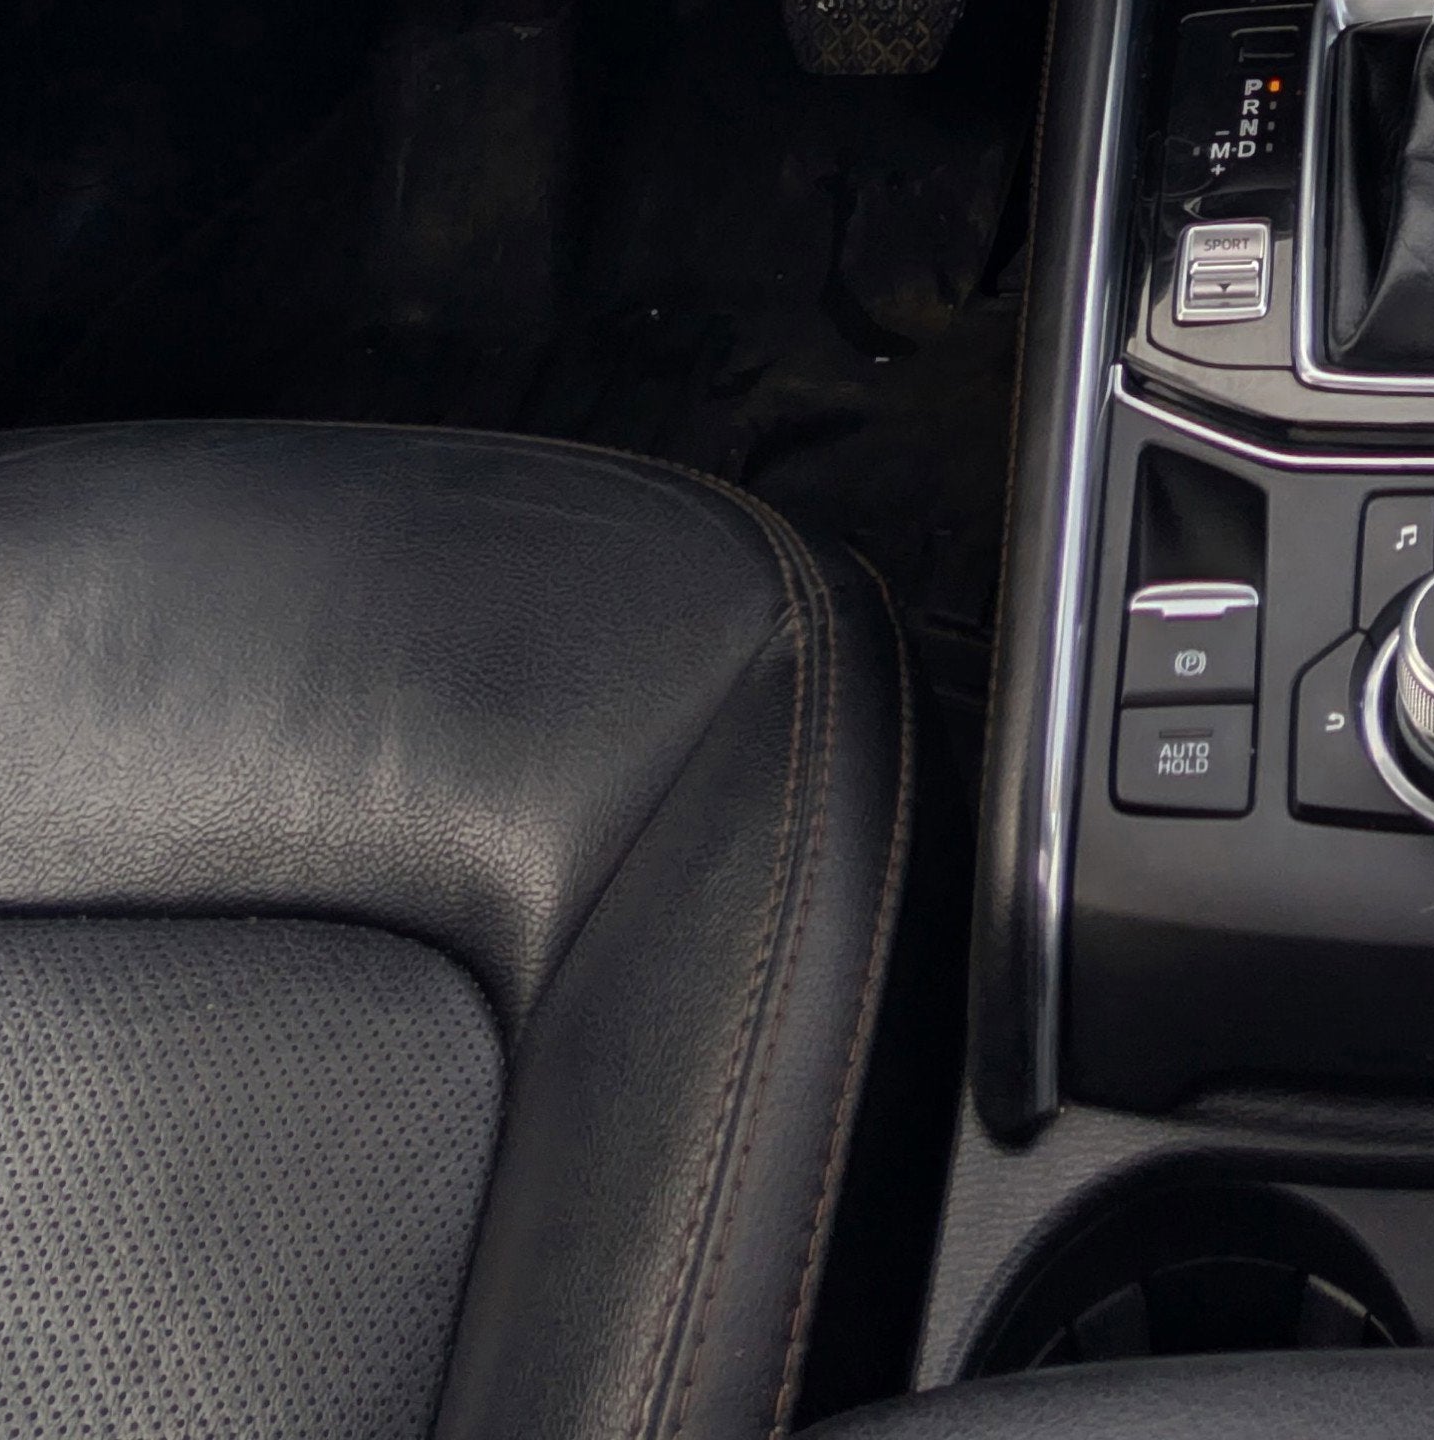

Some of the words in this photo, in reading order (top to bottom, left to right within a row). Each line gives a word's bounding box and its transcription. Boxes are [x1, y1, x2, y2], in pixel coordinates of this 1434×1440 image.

[1243, 78, 1264, 97] P
[1241, 98, 1260, 116] R
[1238, 118, 1260, 137] N
[1203, 237, 1250, 252] SPORT
[1159, 742, 1211, 759] AUTO
[1157, 757, 1210, 776] HOLD
